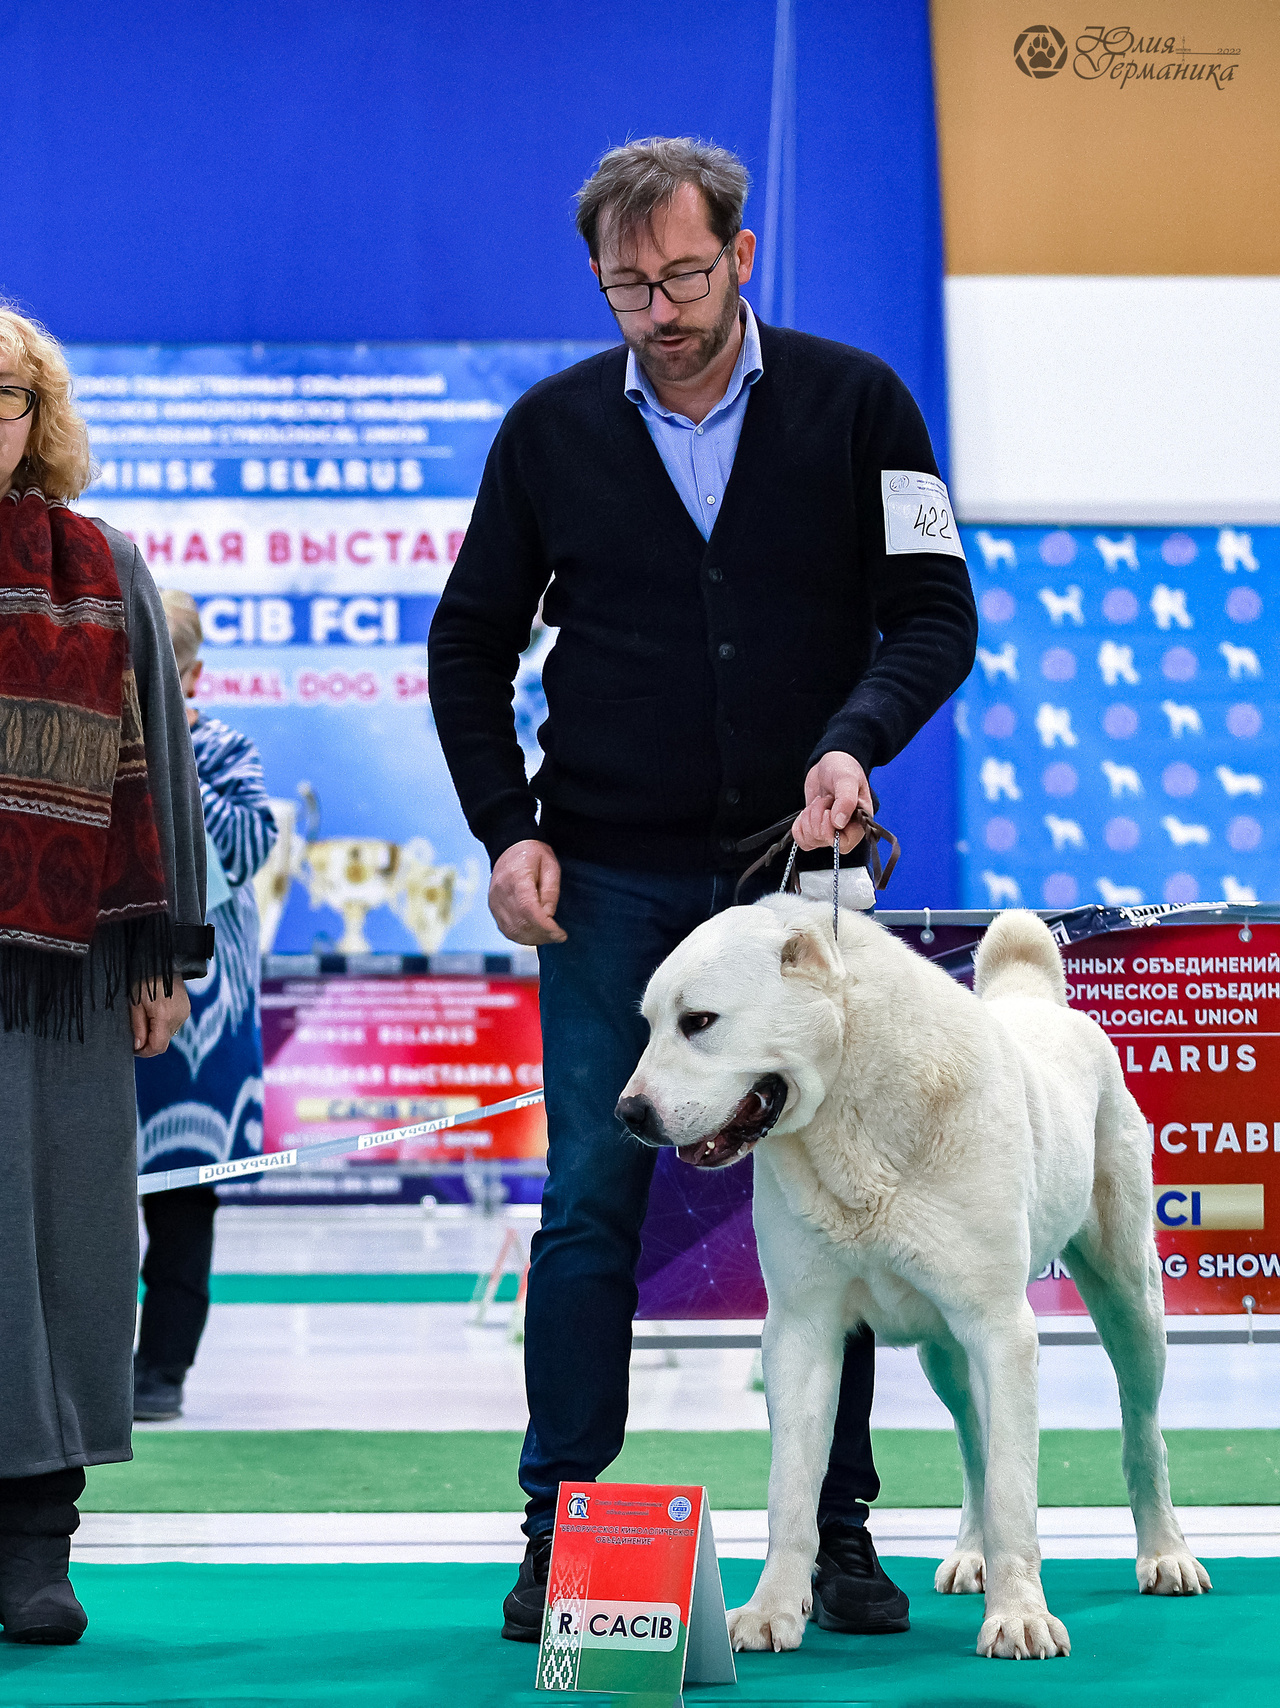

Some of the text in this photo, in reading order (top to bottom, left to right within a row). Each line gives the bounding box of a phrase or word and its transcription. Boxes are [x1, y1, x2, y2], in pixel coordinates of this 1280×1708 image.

[242, 459, 422, 491] BELARUS
[914, 504, 952, 539] 422
[311, 599, 399, 643] FCI
[1132, 953, 1280, 976] ОБЪЕДИНЕНИЙ
[1084, 1008, 1258, 1026] OLOGICAL UNION
[1117, 1044, 1257, 1073] LARUS
[1151, 1122, 1280, 1153] СТАВ
[621, 1526, 695, 1537] КИНОЛОГИЧЕСКОЕ
[558, 1612, 673, 1639] R. CACIB
